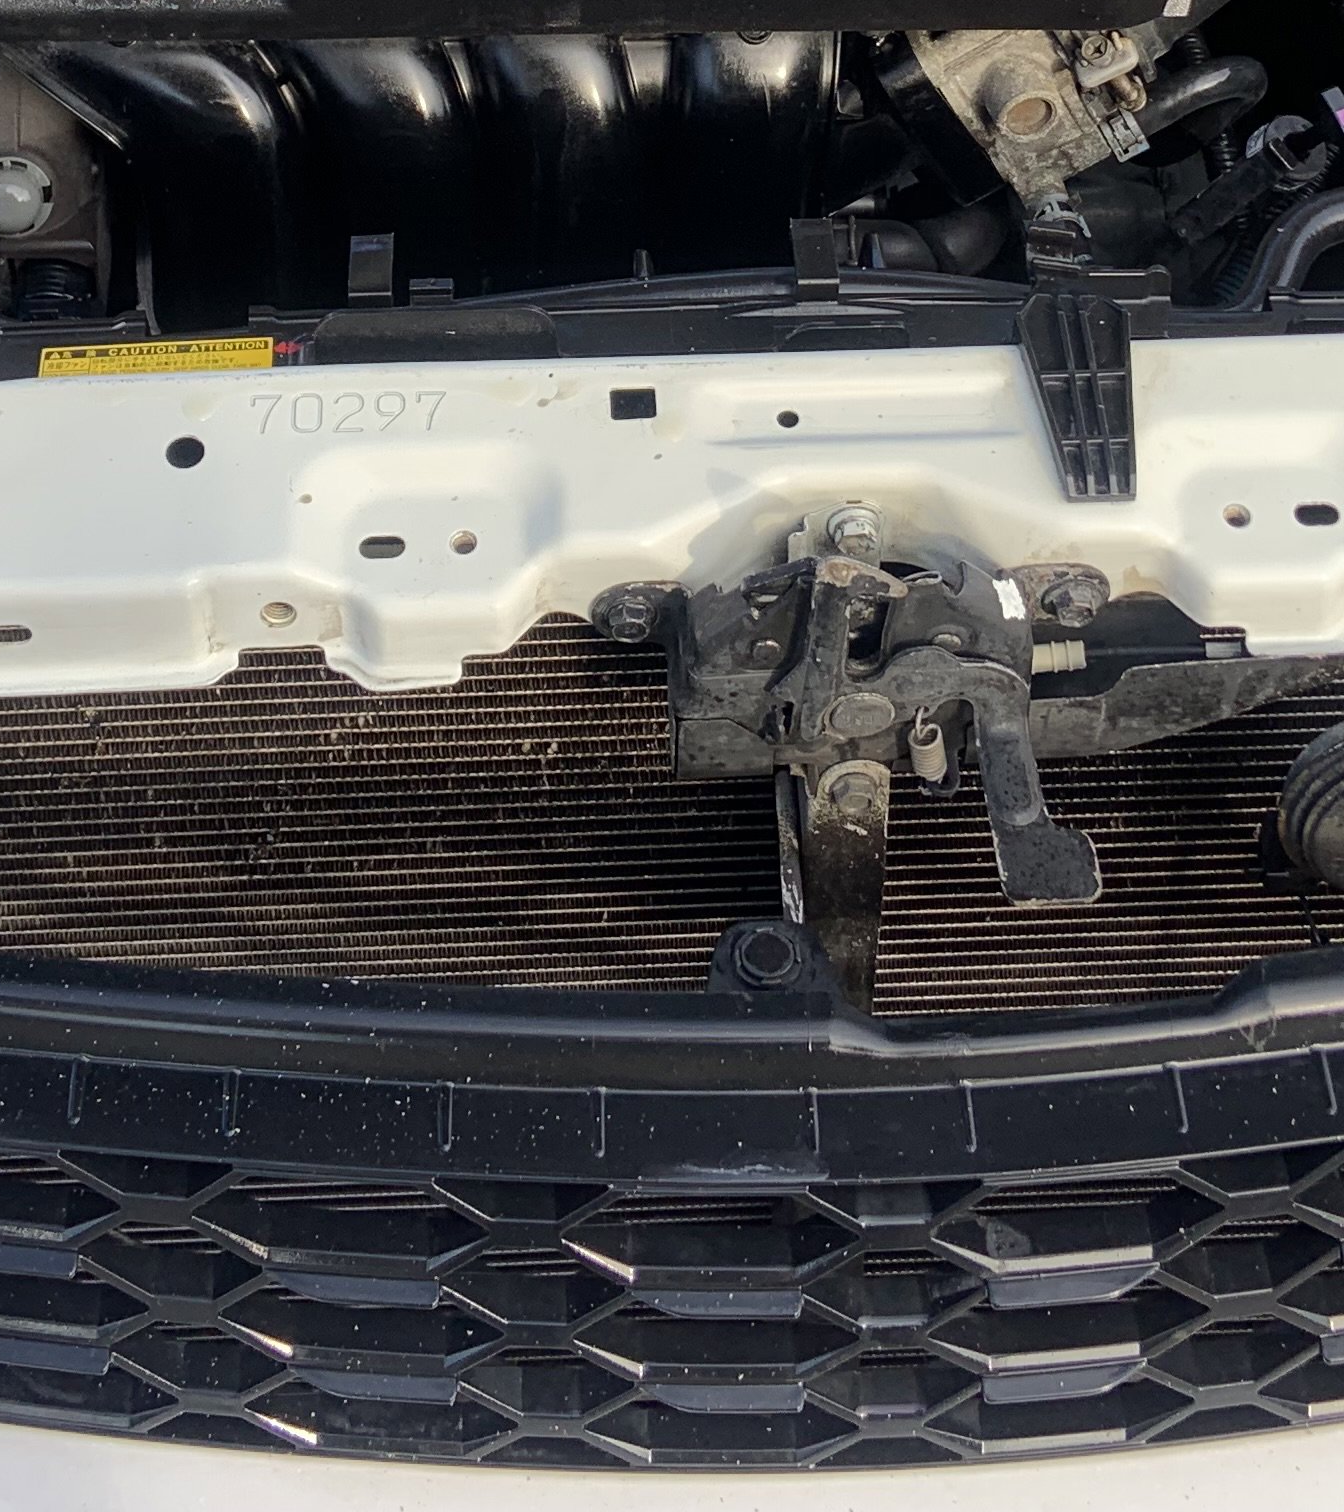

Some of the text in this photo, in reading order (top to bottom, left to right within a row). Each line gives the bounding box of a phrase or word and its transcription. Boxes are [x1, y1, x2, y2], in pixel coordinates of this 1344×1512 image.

[108, 340, 266, 357] CAUTION ATTENTION
[249, 389, 447, 436] 70297
